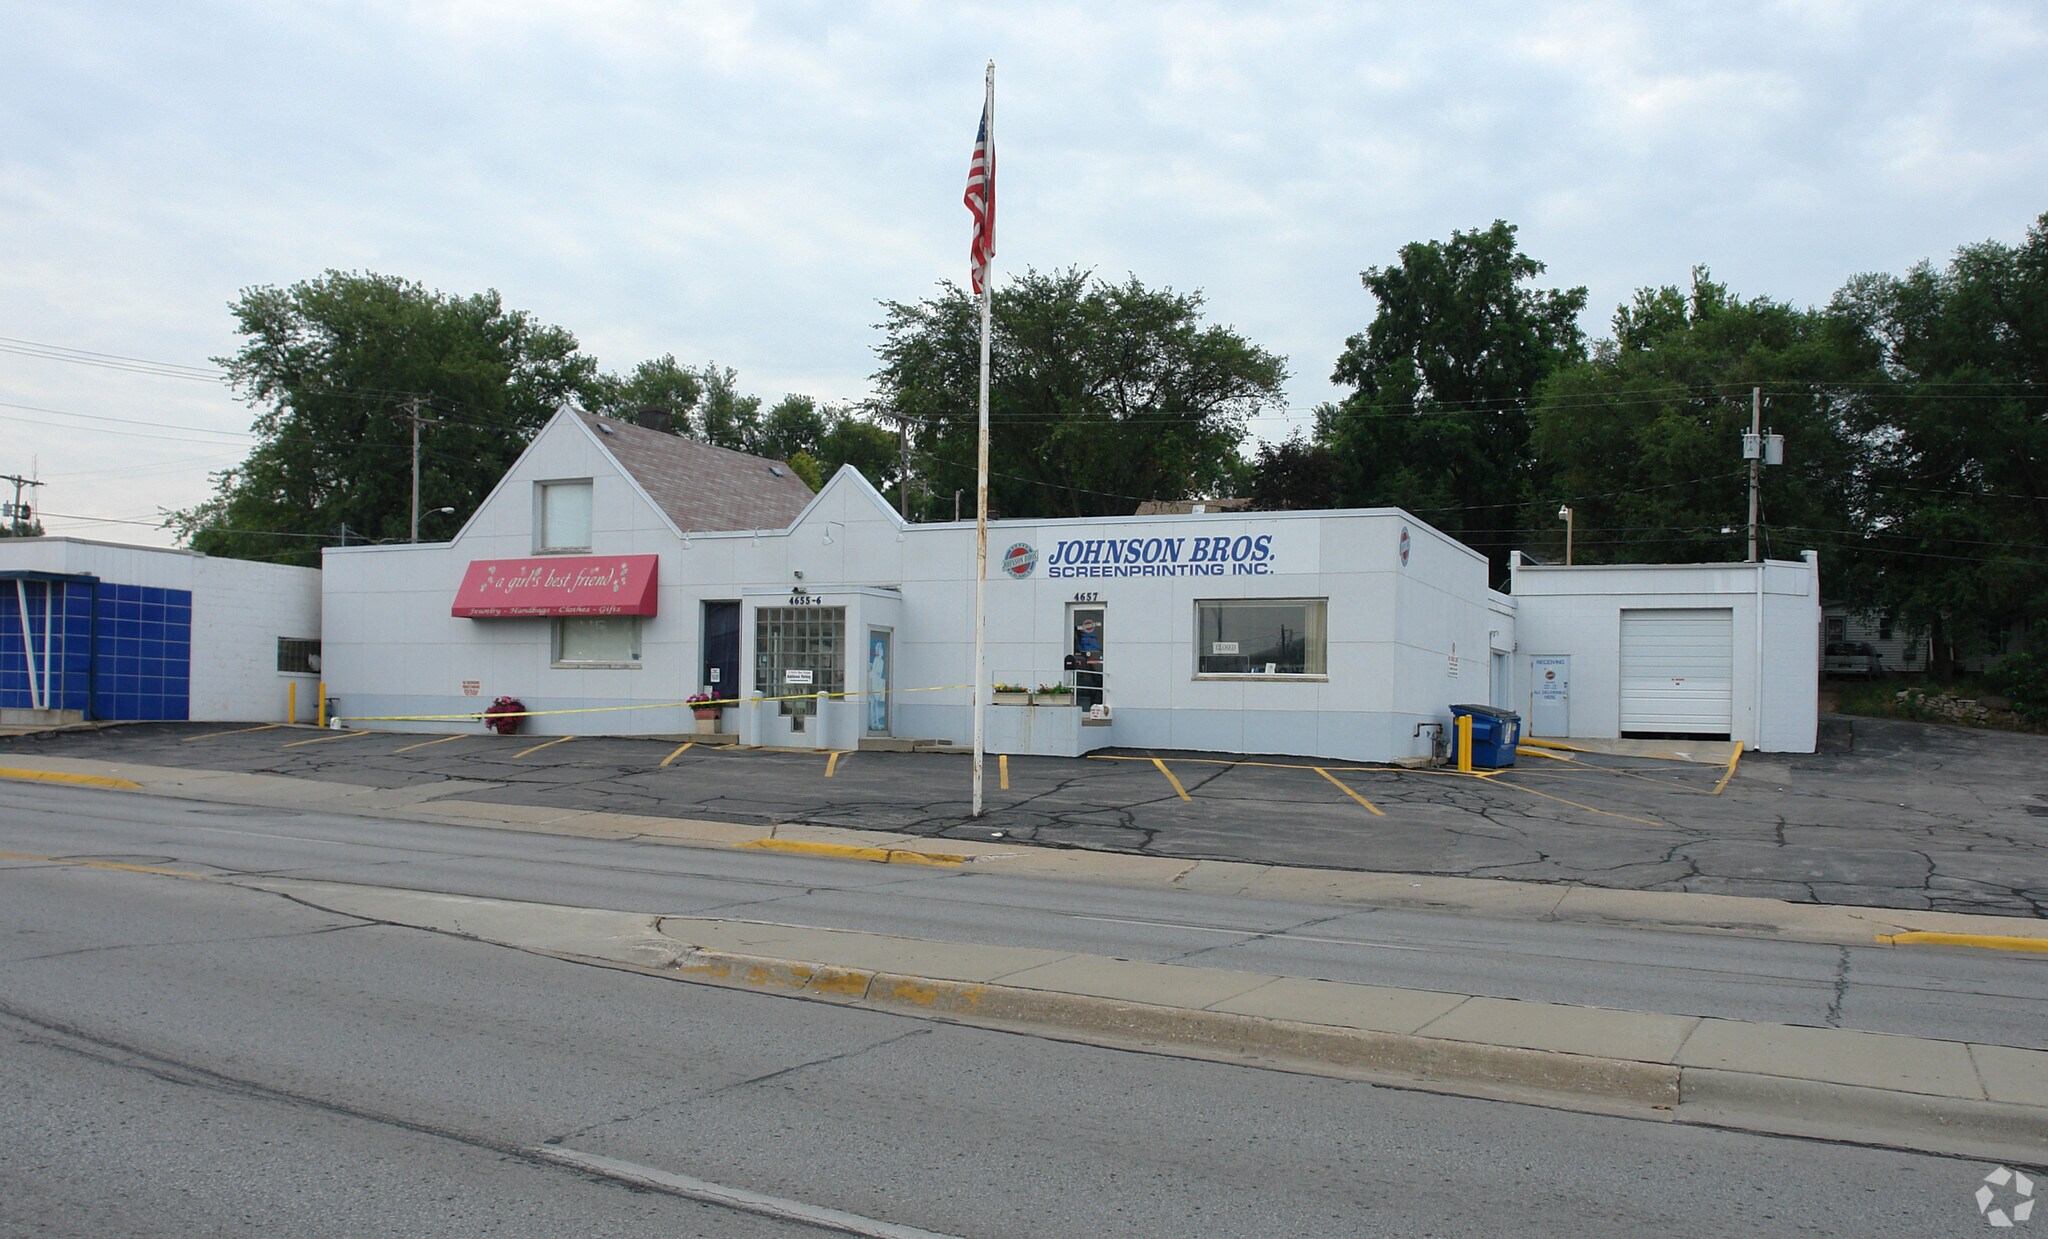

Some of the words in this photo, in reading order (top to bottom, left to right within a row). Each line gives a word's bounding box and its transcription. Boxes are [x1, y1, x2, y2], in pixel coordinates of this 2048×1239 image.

[1048, 538, 1185, 565] JOHNSON
[1188, 535, 1275, 562] BROS.
[1048, 563, 1225, 578] SCREENPRINTING
[1232, 563, 1274, 576] INC.
[495, 577, 505, 588] a
[544, 568, 572, 588] best
[567, 567, 614, 593] friend
[789, 596, 822, 605] 4655-6
[1074, 592, 1098, 601] 4657
[509, 607, 550, 616] Handbags
[599, 605, 621, 614] Gifts
[1215, 643, 1237, 651] CLOSED
